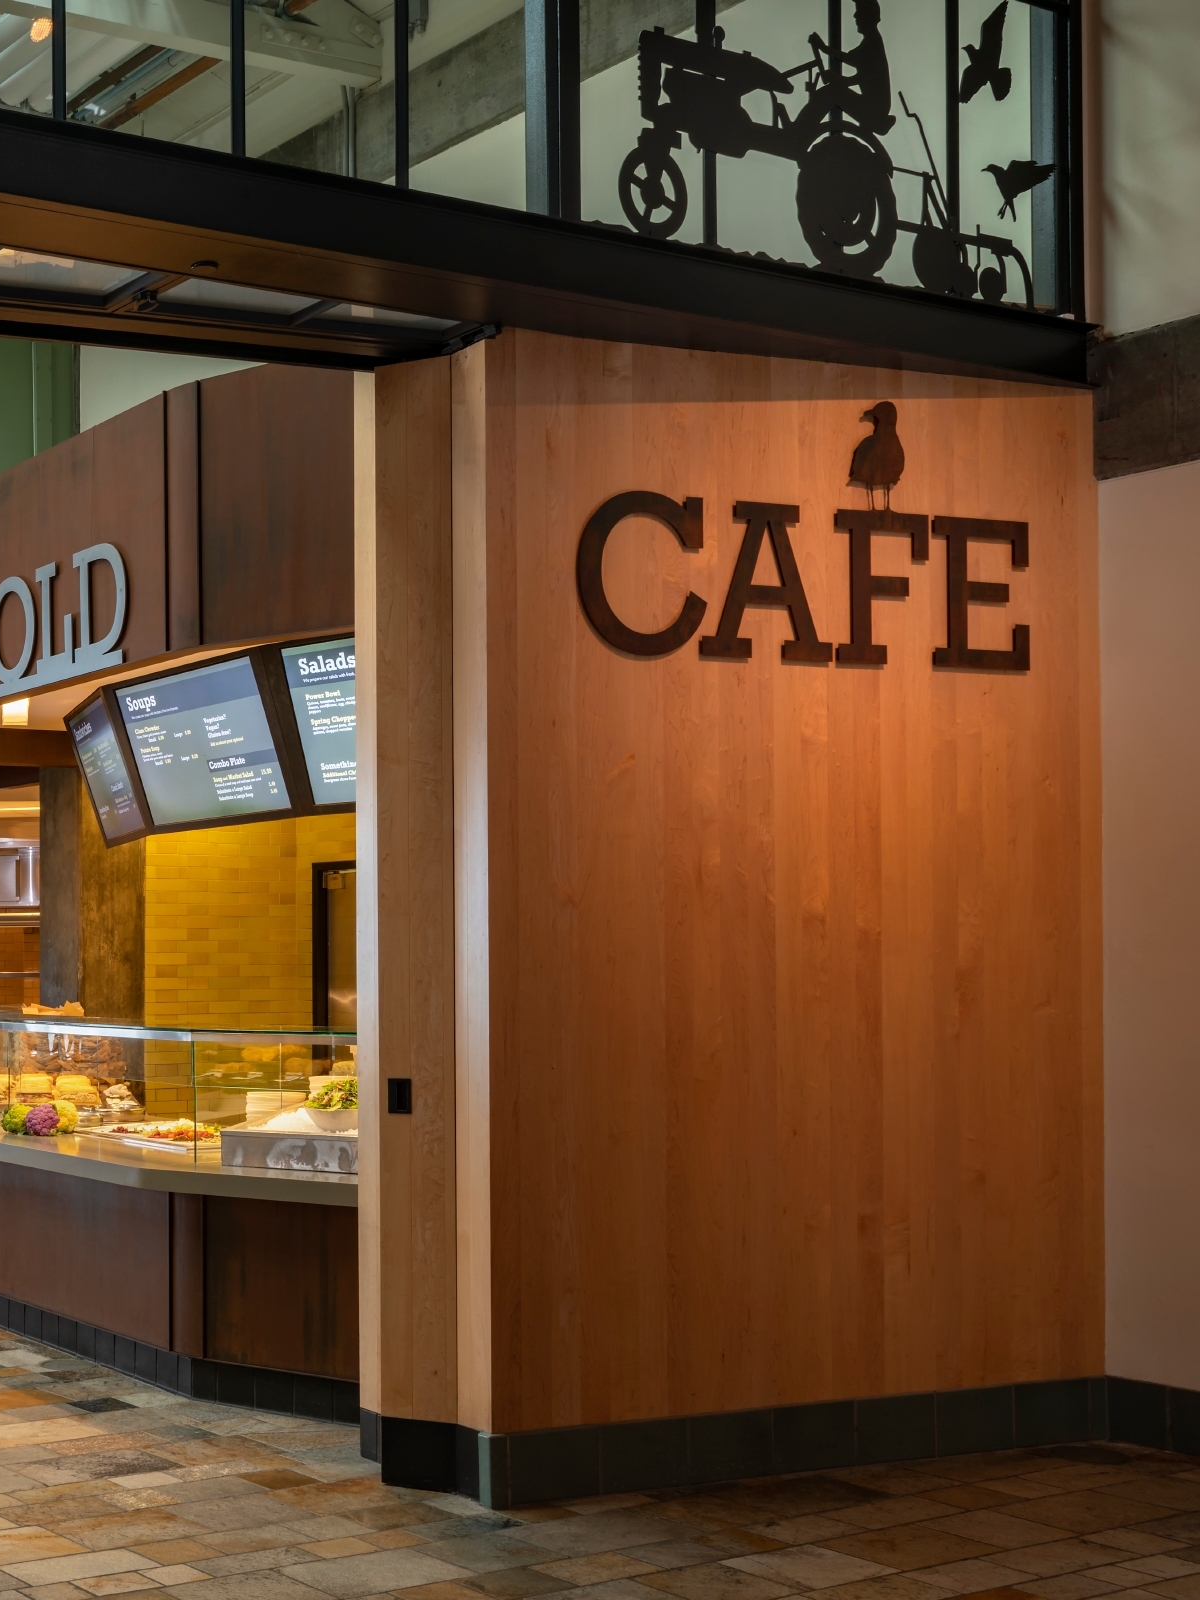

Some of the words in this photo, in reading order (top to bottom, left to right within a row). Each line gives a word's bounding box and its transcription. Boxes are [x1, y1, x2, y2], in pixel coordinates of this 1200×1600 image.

[576, 490, 1030, 671] CAFE
[298, 652, 356, 675] Salads
[325, 690, 340, 698] Bowl
[126, 695, 156, 712] Soups
[311, 718, 331, 726] Spring
[209, 760, 230, 770] Combo
[230, 757, 246, 766] Plate
